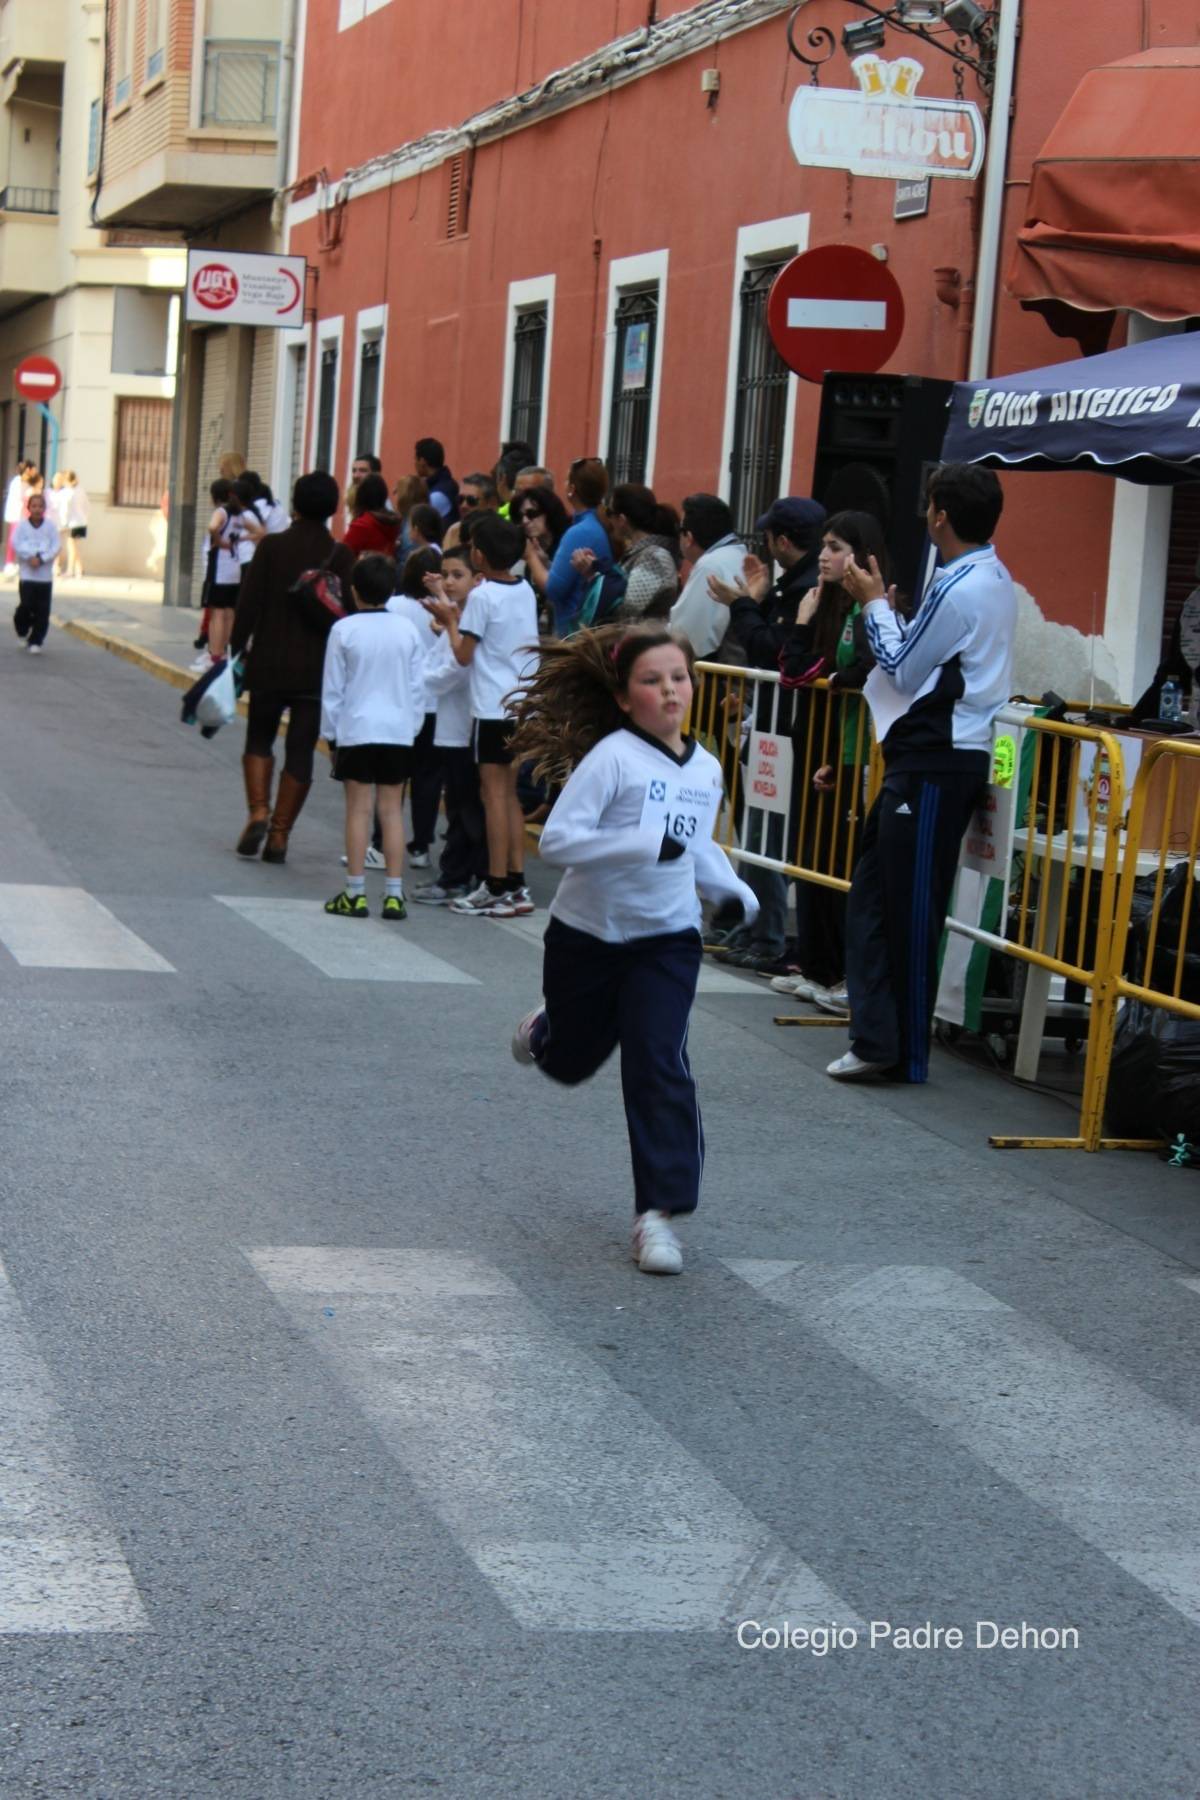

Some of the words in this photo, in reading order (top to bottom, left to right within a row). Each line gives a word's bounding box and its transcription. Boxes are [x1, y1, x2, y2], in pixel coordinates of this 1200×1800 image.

[199, 269, 233, 291] UGT
[984, 391, 1041, 428] Club
[664, 812, 697, 838] 163
